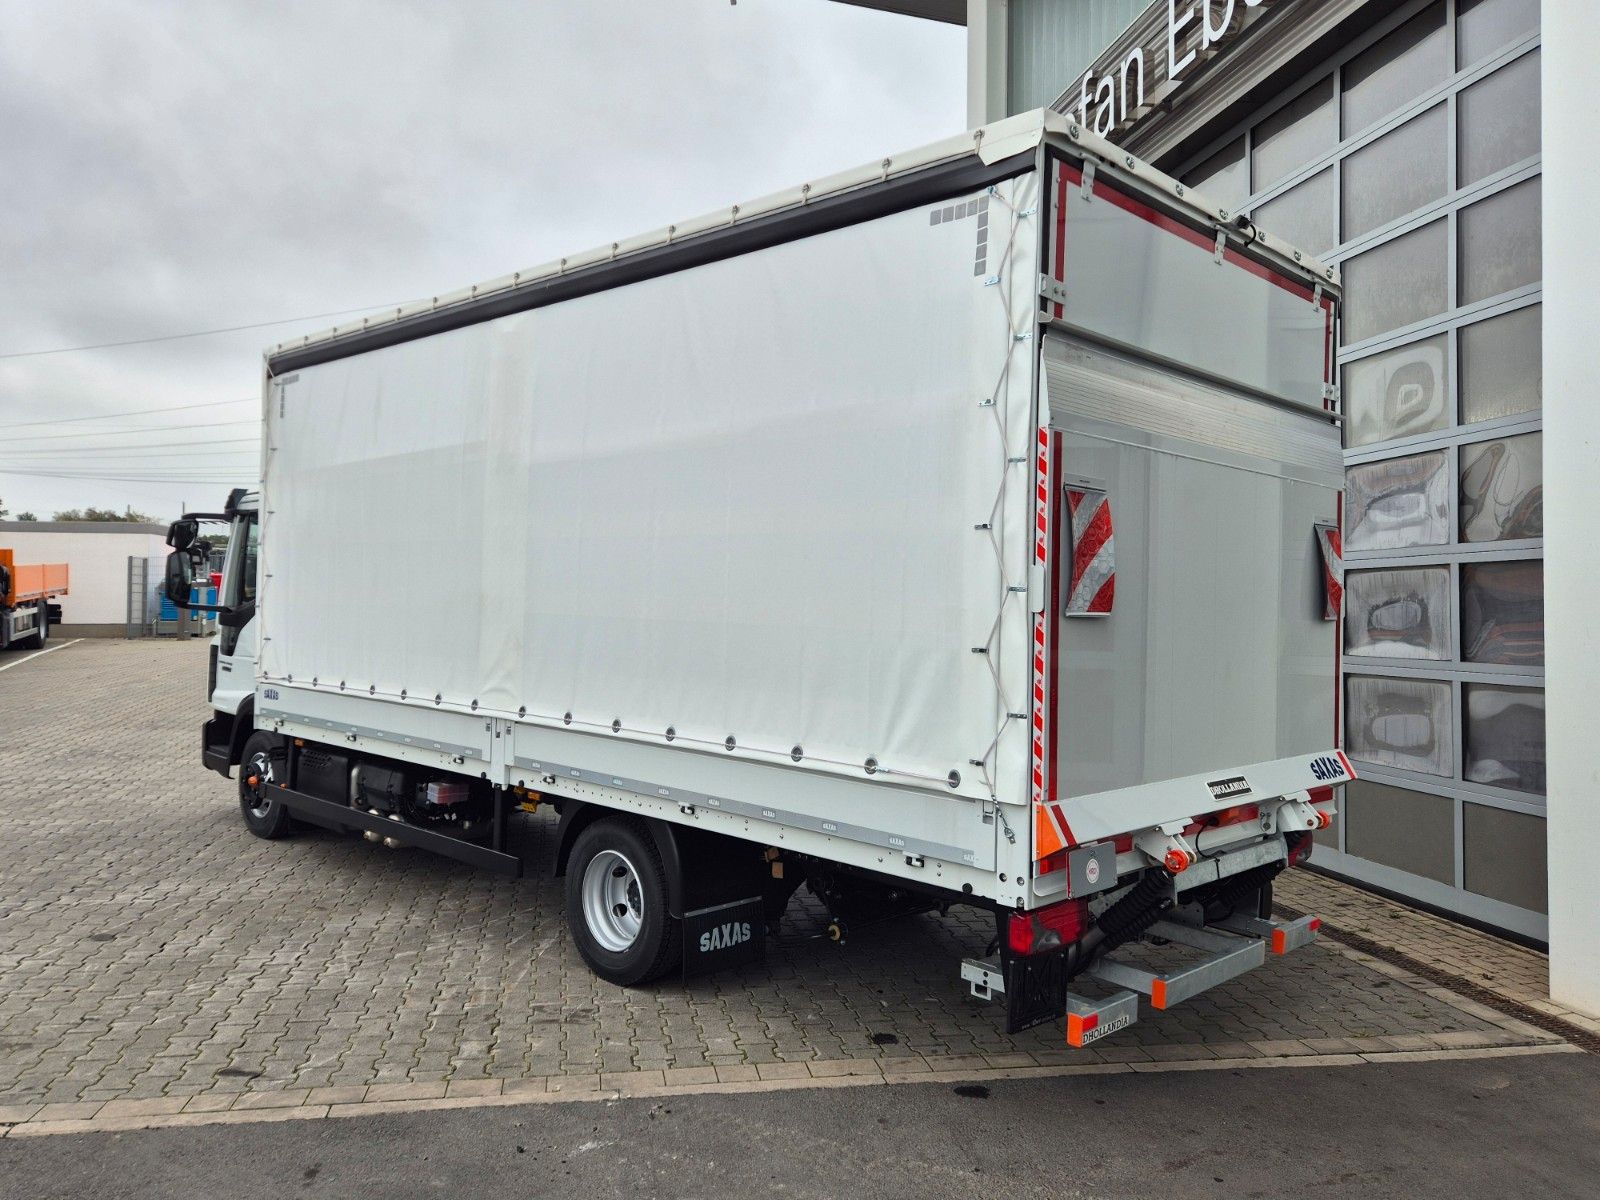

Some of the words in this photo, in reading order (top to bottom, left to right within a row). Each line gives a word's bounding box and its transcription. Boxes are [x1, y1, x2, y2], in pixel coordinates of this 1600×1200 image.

[1066, 47, 1144, 139] fan
[1168, 0, 1263, 80] Eb
[1310, 756, 1345, 780] SAXAS
[1209, 780, 1250, 796] DHOLLANDIA
[700, 922, 751, 952] SAXAS
[1082, 1015, 1129, 1044] DHOLLANDIA
